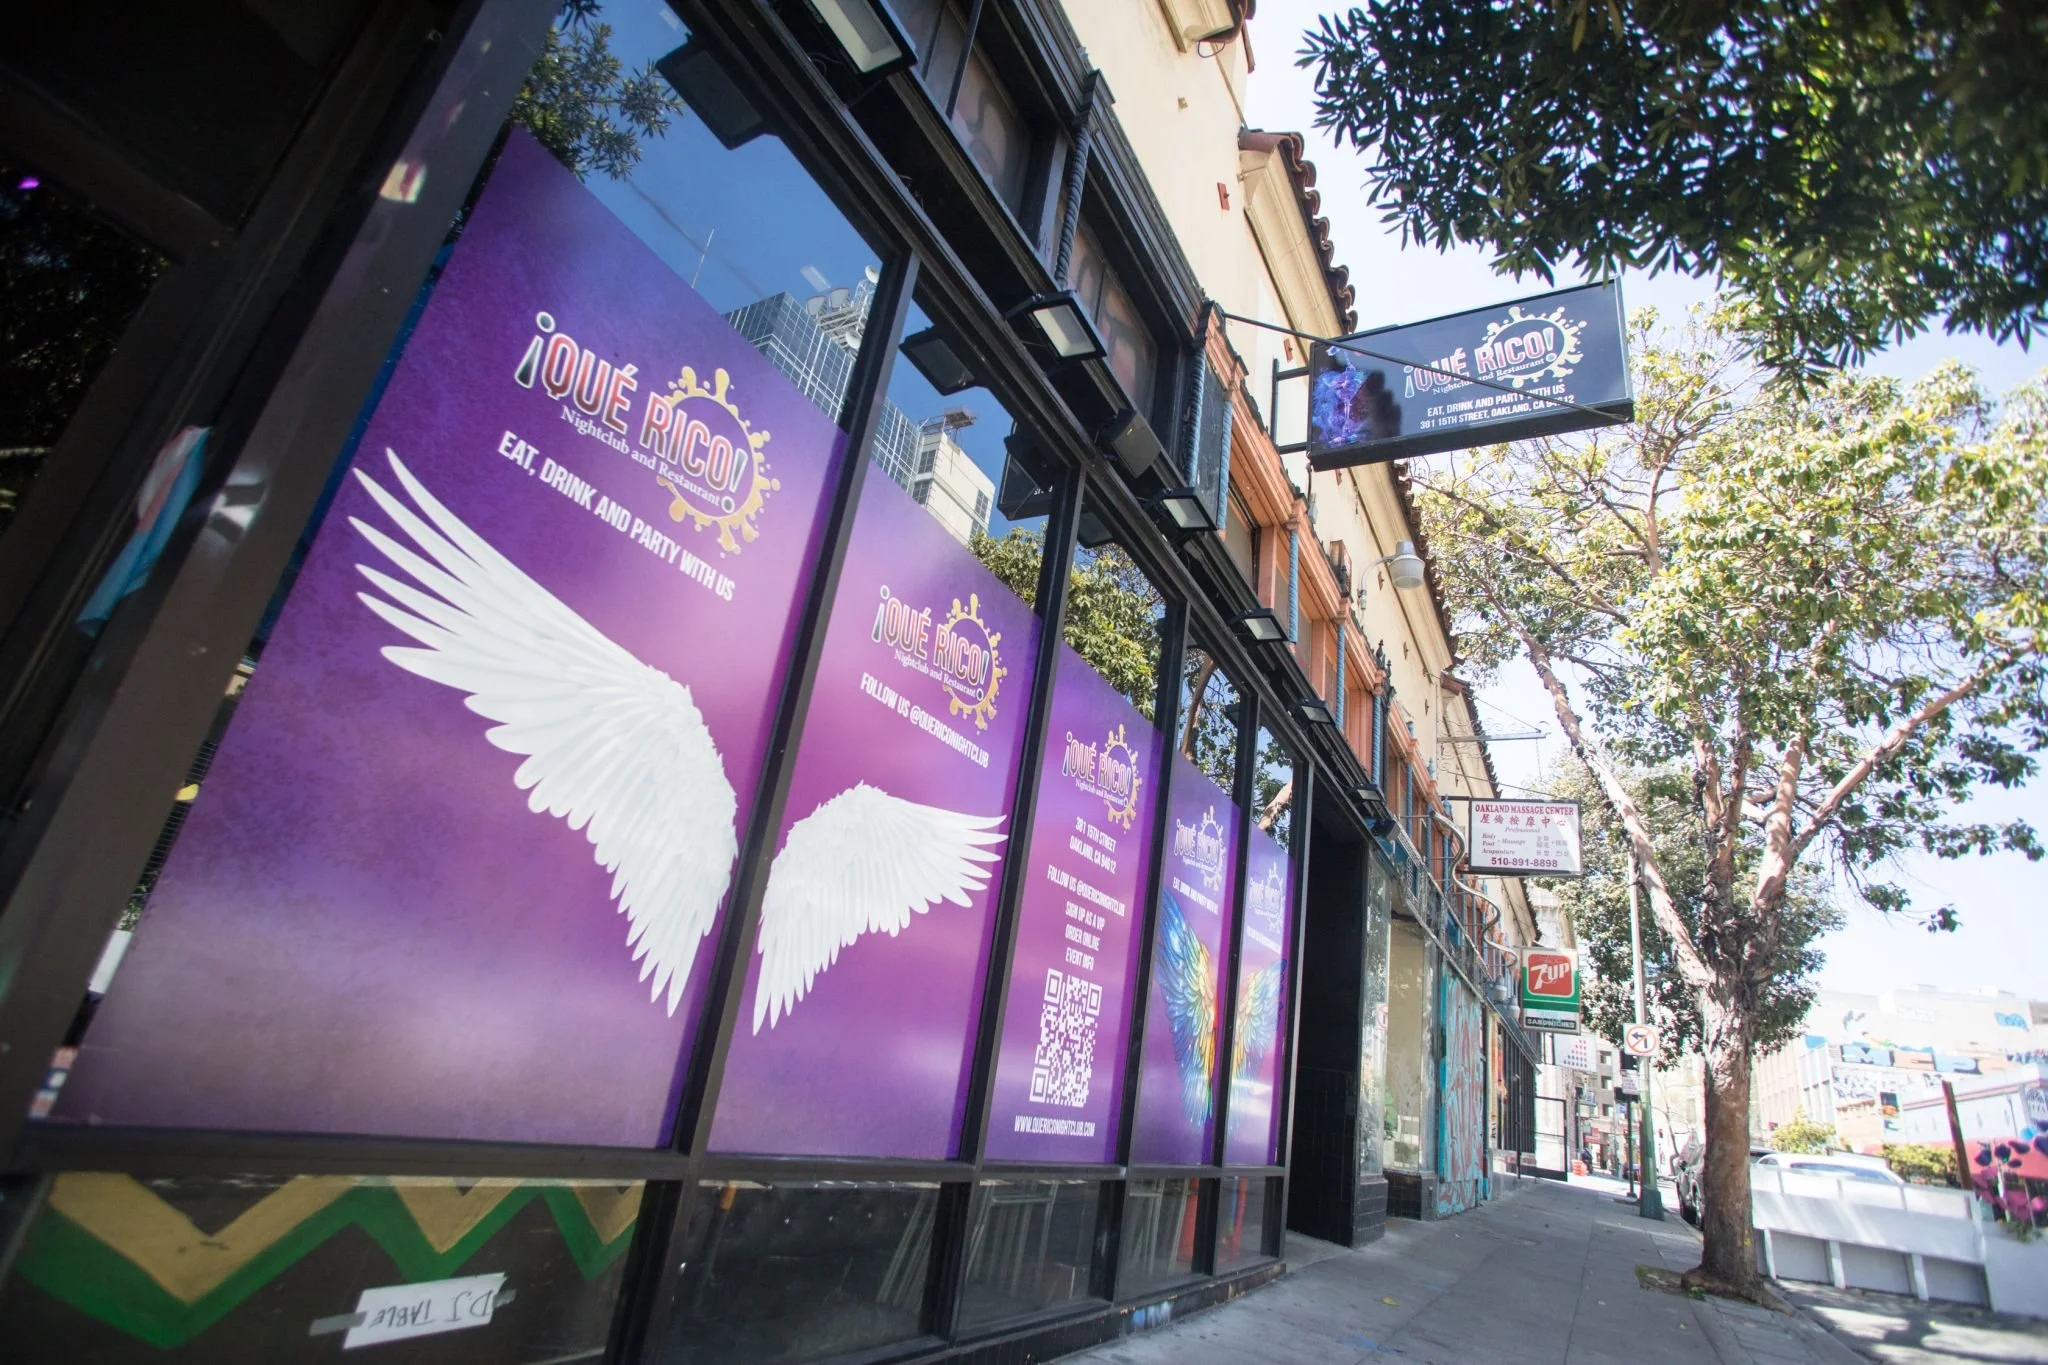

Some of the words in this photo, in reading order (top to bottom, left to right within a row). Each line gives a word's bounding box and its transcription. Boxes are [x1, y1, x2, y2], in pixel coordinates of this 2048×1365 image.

[1474, 327, 1557, 372] RICO!
[1496, 358, 1545, 376] Restaurant
[514, 311, 638, 434] ¡QUÉ
[639, 391, 749, 513] RICO!
[1447, 400, 1474, 413] DRINK
[1475, 396, 1494, 409] AND
[1552, 384, 1565, 394] US
[1420, 420, 1435, 430] 381
[1439, 416, 1457, 426] 15TH
[1459, 410, 1489, 423] STREET,
[1491, 403, 1532, 417] OAKLAND,
[1533, 400, 1545, 410] CA
[560, 405, 630, 453] Nightclub
[631, 446, 656, 470] and
[659, 461, 721, 507] Restaurant
[498, 431, 539, 475] EAT,
[540, 458, 598, 510] DRINK
[594, 495, 631, 533] AND
[630, 518, 682, 564] PARTY
[679, 549, 717, 591] WITH
[715, 571, 735, 601] US
[872, 585, 931, 660] ¡QUÉ
[933, 624, 990, 701] RICO!
[894, 649, 929, 675] Nightclub
[929, 669, 943, 681] and
[944, 675, 977, 698] Restaurant
[860, 672, 898, 709] FOLLOW
[897, 696, 911, 718] US
[909, 705, 989, 768] @QUERICONIGHTCLUB
[1062, 731, 1097, 783] ¡QUÉ
[1098, 753, 1132, 807] RICO!
[1475, 803, 1509, 814] OAKLAND
[1511, 805, 1544, 815] MASSAGE
[1545, 806, 1574, 816] CENTER
[1099, 831, 1117, 853] STREET
[1491, 857, 1558, 868] 510-891-8898
[1047, 864, 1070, 888] FOLLOW
[1069, 875, 1077, 893] US
[1065, 923, 1083, 945] ORDER
[1065, 947, 1083, 966] EVENT
[369, 1298, 438, 1329] TABLE
